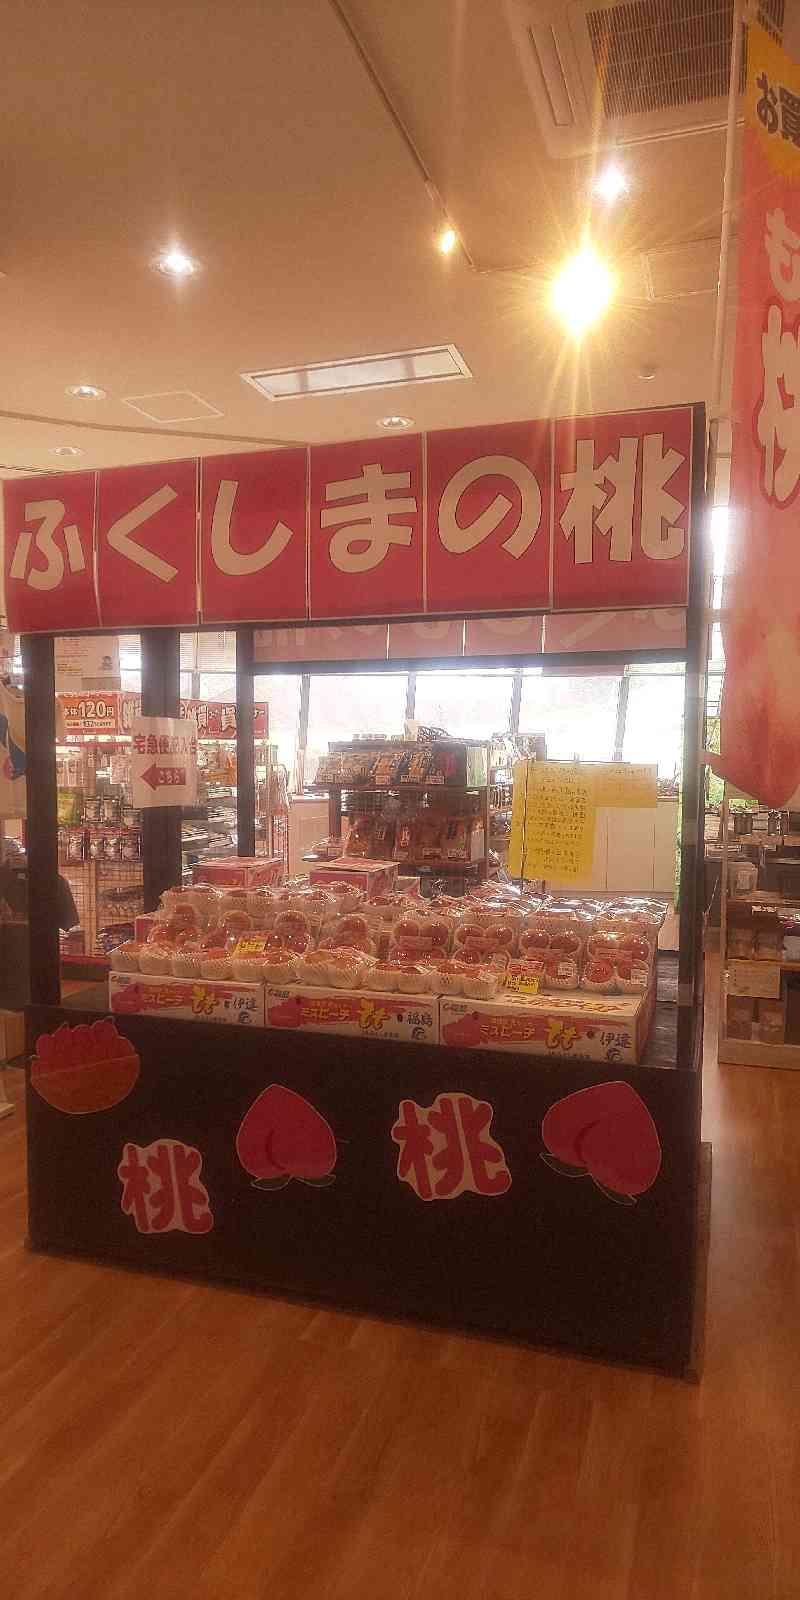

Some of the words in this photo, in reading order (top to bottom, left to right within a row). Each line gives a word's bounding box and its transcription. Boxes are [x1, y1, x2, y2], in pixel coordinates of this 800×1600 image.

[9, 432, 687, 592] ふくしまの桃
[158, 768, 181, 785] こちら
[119, 1140, 213, 1233] 桃
[393, 1094, 511, 1200] 桃
